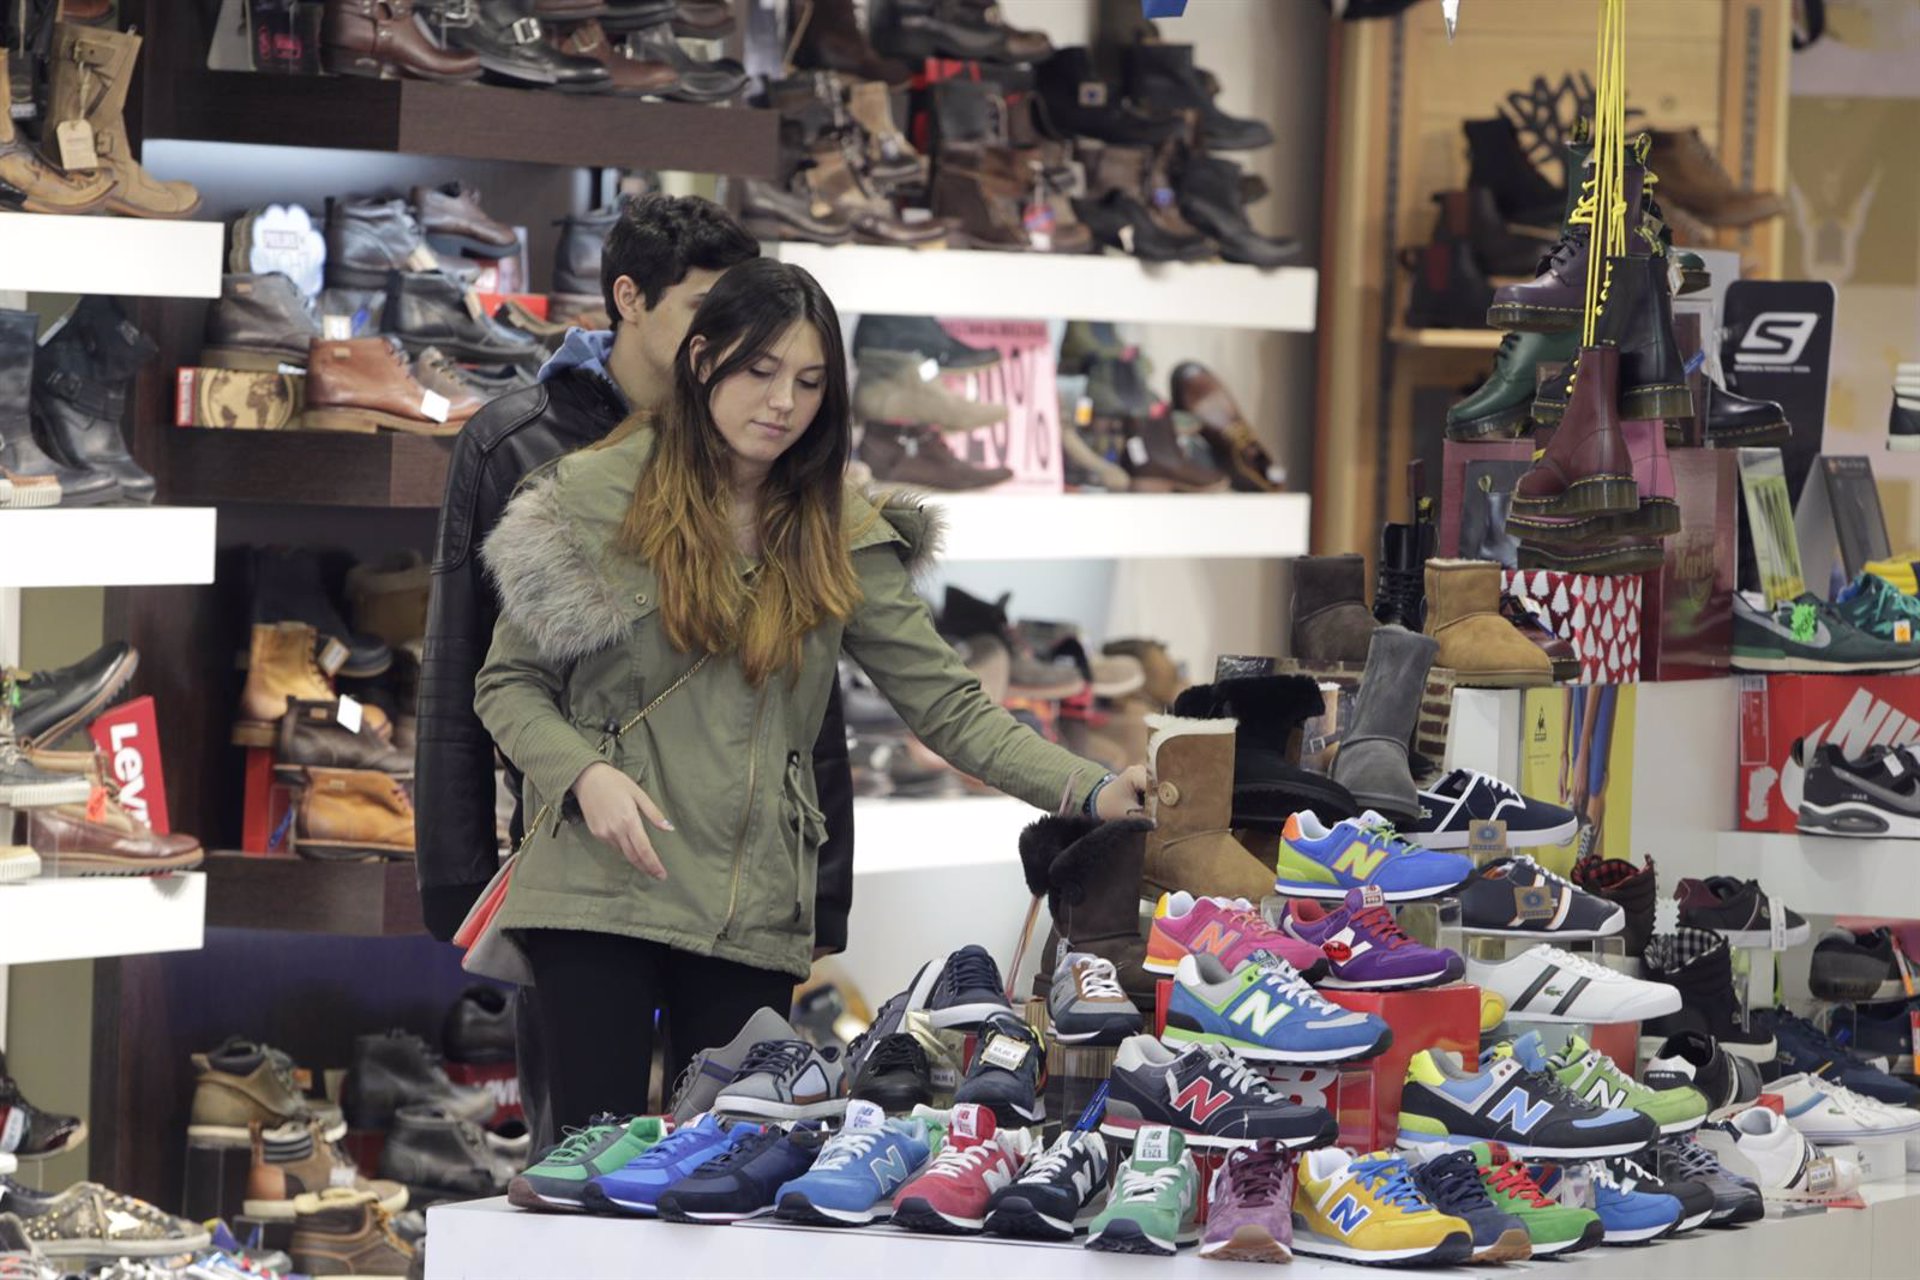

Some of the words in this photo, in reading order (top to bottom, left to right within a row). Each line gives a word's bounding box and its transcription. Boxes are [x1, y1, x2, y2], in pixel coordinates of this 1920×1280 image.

[1331, 840, 1389, 881] N
[1188, 919, 1242, 956] N
[1228, 988, 1295, 1038] N
[1169, 1075, 1235, 1126] N
[1486, 1085, 1555, 1136] N
[1583, 1076, 1629, 1110] N
[870, 1144, 908, 1194] N
[982, 1158, 1011, 1195] N
[1071, 1159, 1092, 1206] N
[1326, 1193, 1373, 1236] N
